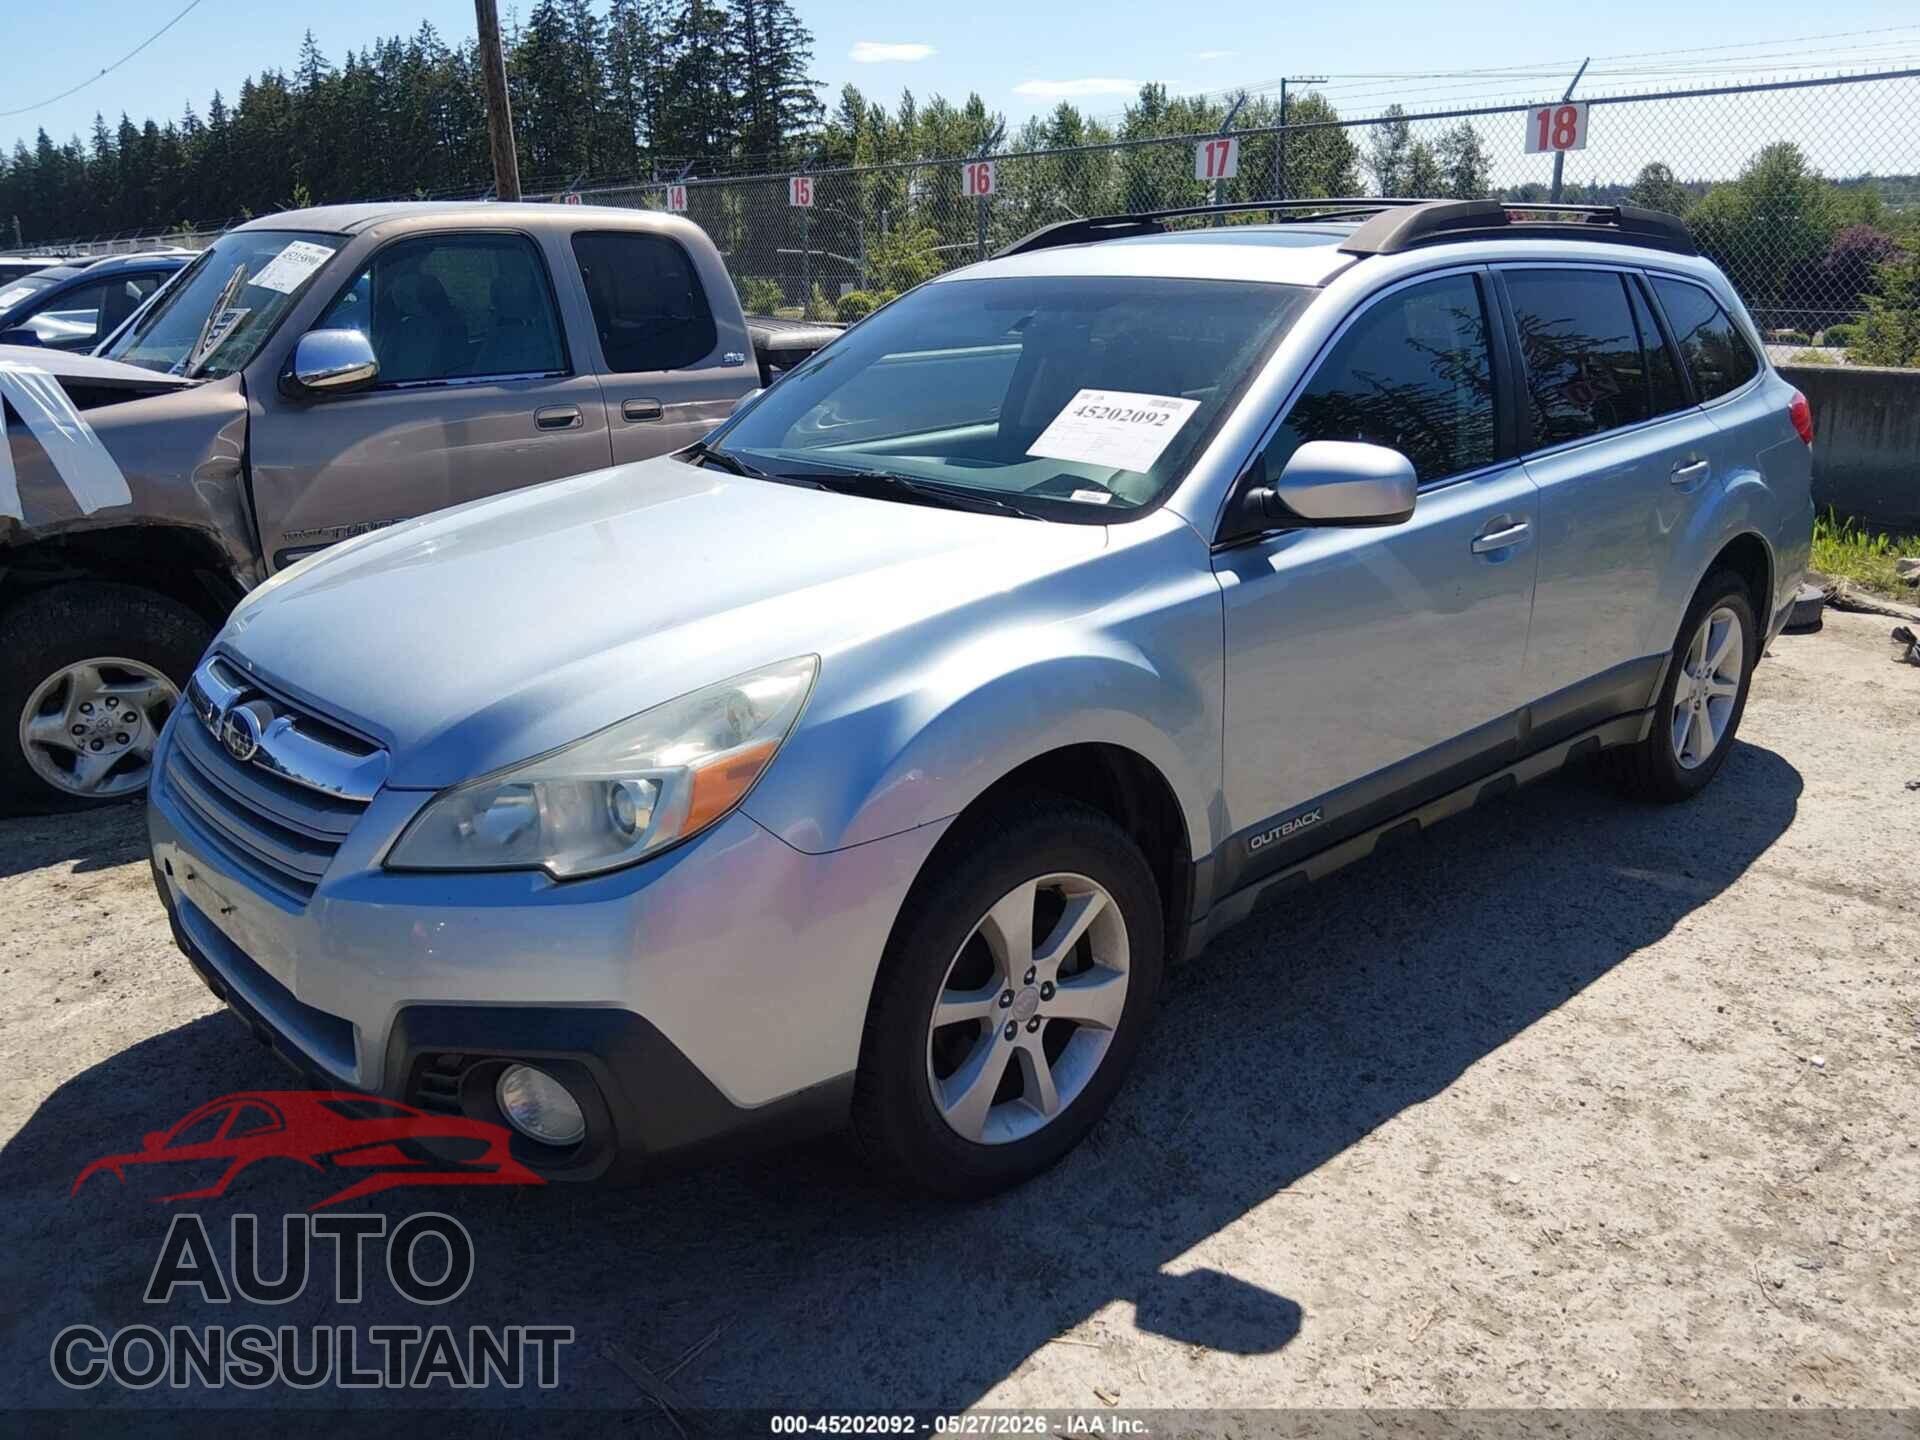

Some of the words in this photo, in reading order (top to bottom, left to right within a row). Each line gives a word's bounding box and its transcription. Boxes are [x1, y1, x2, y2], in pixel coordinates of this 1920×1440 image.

[1537, 106, 1577, 151] 18
[1206, 141, 1229, 177] 17
[793, 178, 810, 205] 15
[968, 163, 990, 194] 16
[671, 187, 683, 209] 14
[1072, 403, 1171, 427] 45202092
[1250, 807, 1322, 849] OUTBACK
